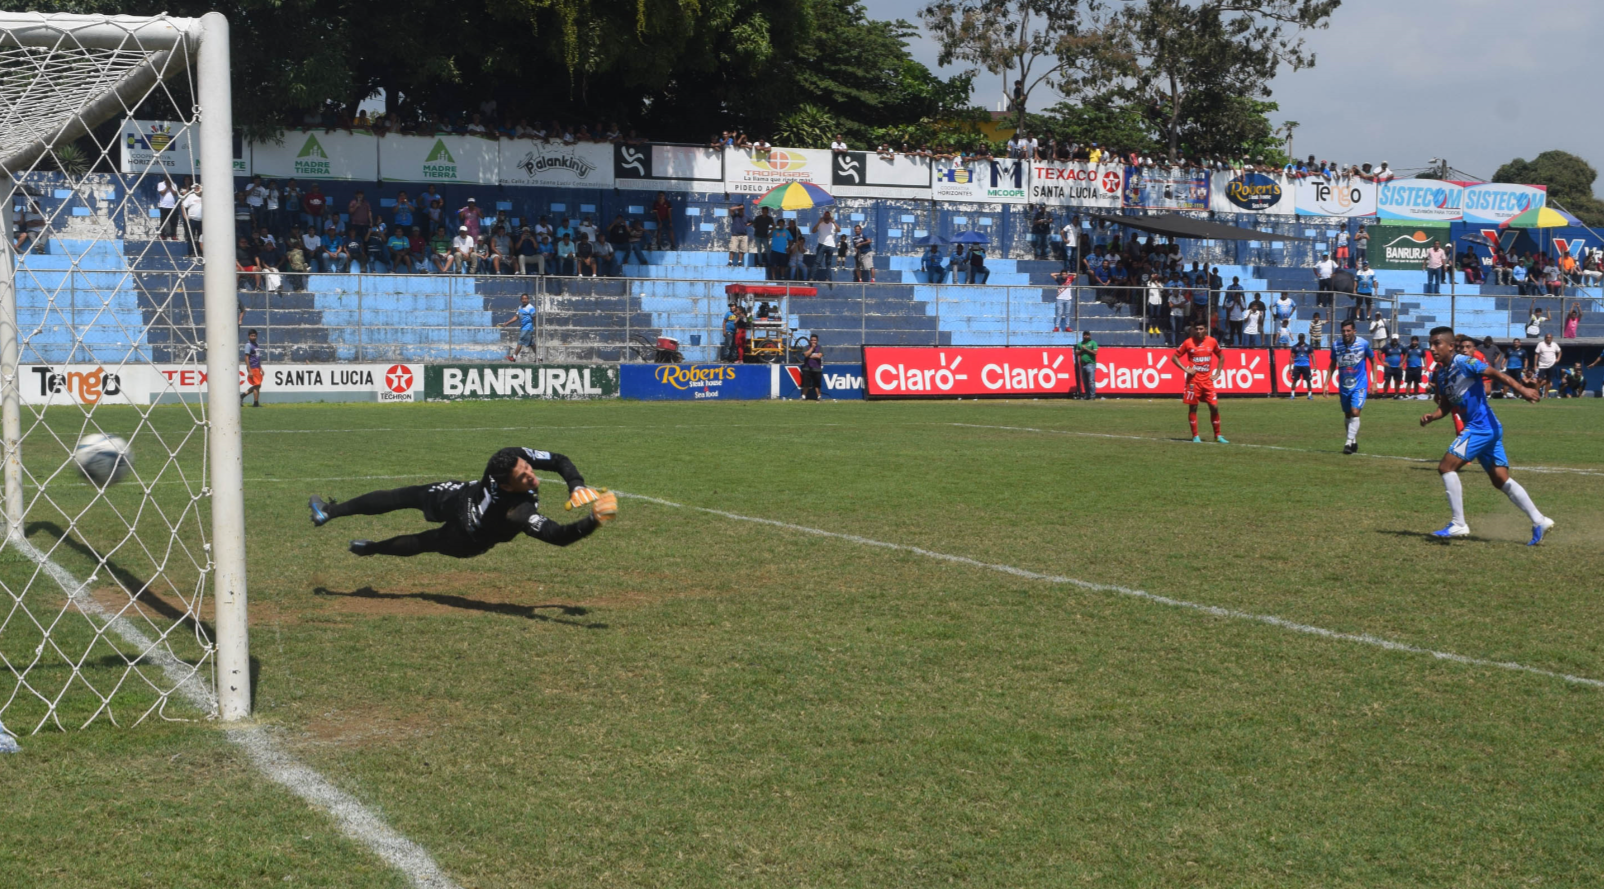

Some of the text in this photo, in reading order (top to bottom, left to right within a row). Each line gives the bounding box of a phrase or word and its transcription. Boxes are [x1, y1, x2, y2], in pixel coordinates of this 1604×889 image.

[294, 167, 330, 175] TIERRA
[422, 165, 457, 173] MADRE
[524, 154, 588, 177] Palankiny
[744, 170, 810, 178] TROPIGAS
[1034, 167, 1098, 182] TEXACO
[422, 171, 457, 179] TIERRA
[735, 184, 763, 192] PIDELO
[987, 189, 1025, 197] MICOOPE
[1033, 185, 1098, 199] SANTA LUCIA
[1225, 181, 1281, 202] Robert's
[1311, 182, 1362, 208] Tengo
[1379, 185, 1463, 209] SISTECOM
[1465, 189, 1546, 213] SISTECOM
[274, 370, 323, 386] SANTA
[331, 370, 374, 385] LUCIA
[442, 368, 603, 396] BANRURAL
[654, 364, 736, 390] Robert's
[689, 380, 704, 388] Steak
[874, 363, 954, 391] Claro
[981, 362, 1056, 390] Claro
[1095, 362, 1160, 389] Claro
[31, 366, 121, 405] Tengo
[380, 392, 412, 400] TECHRON
